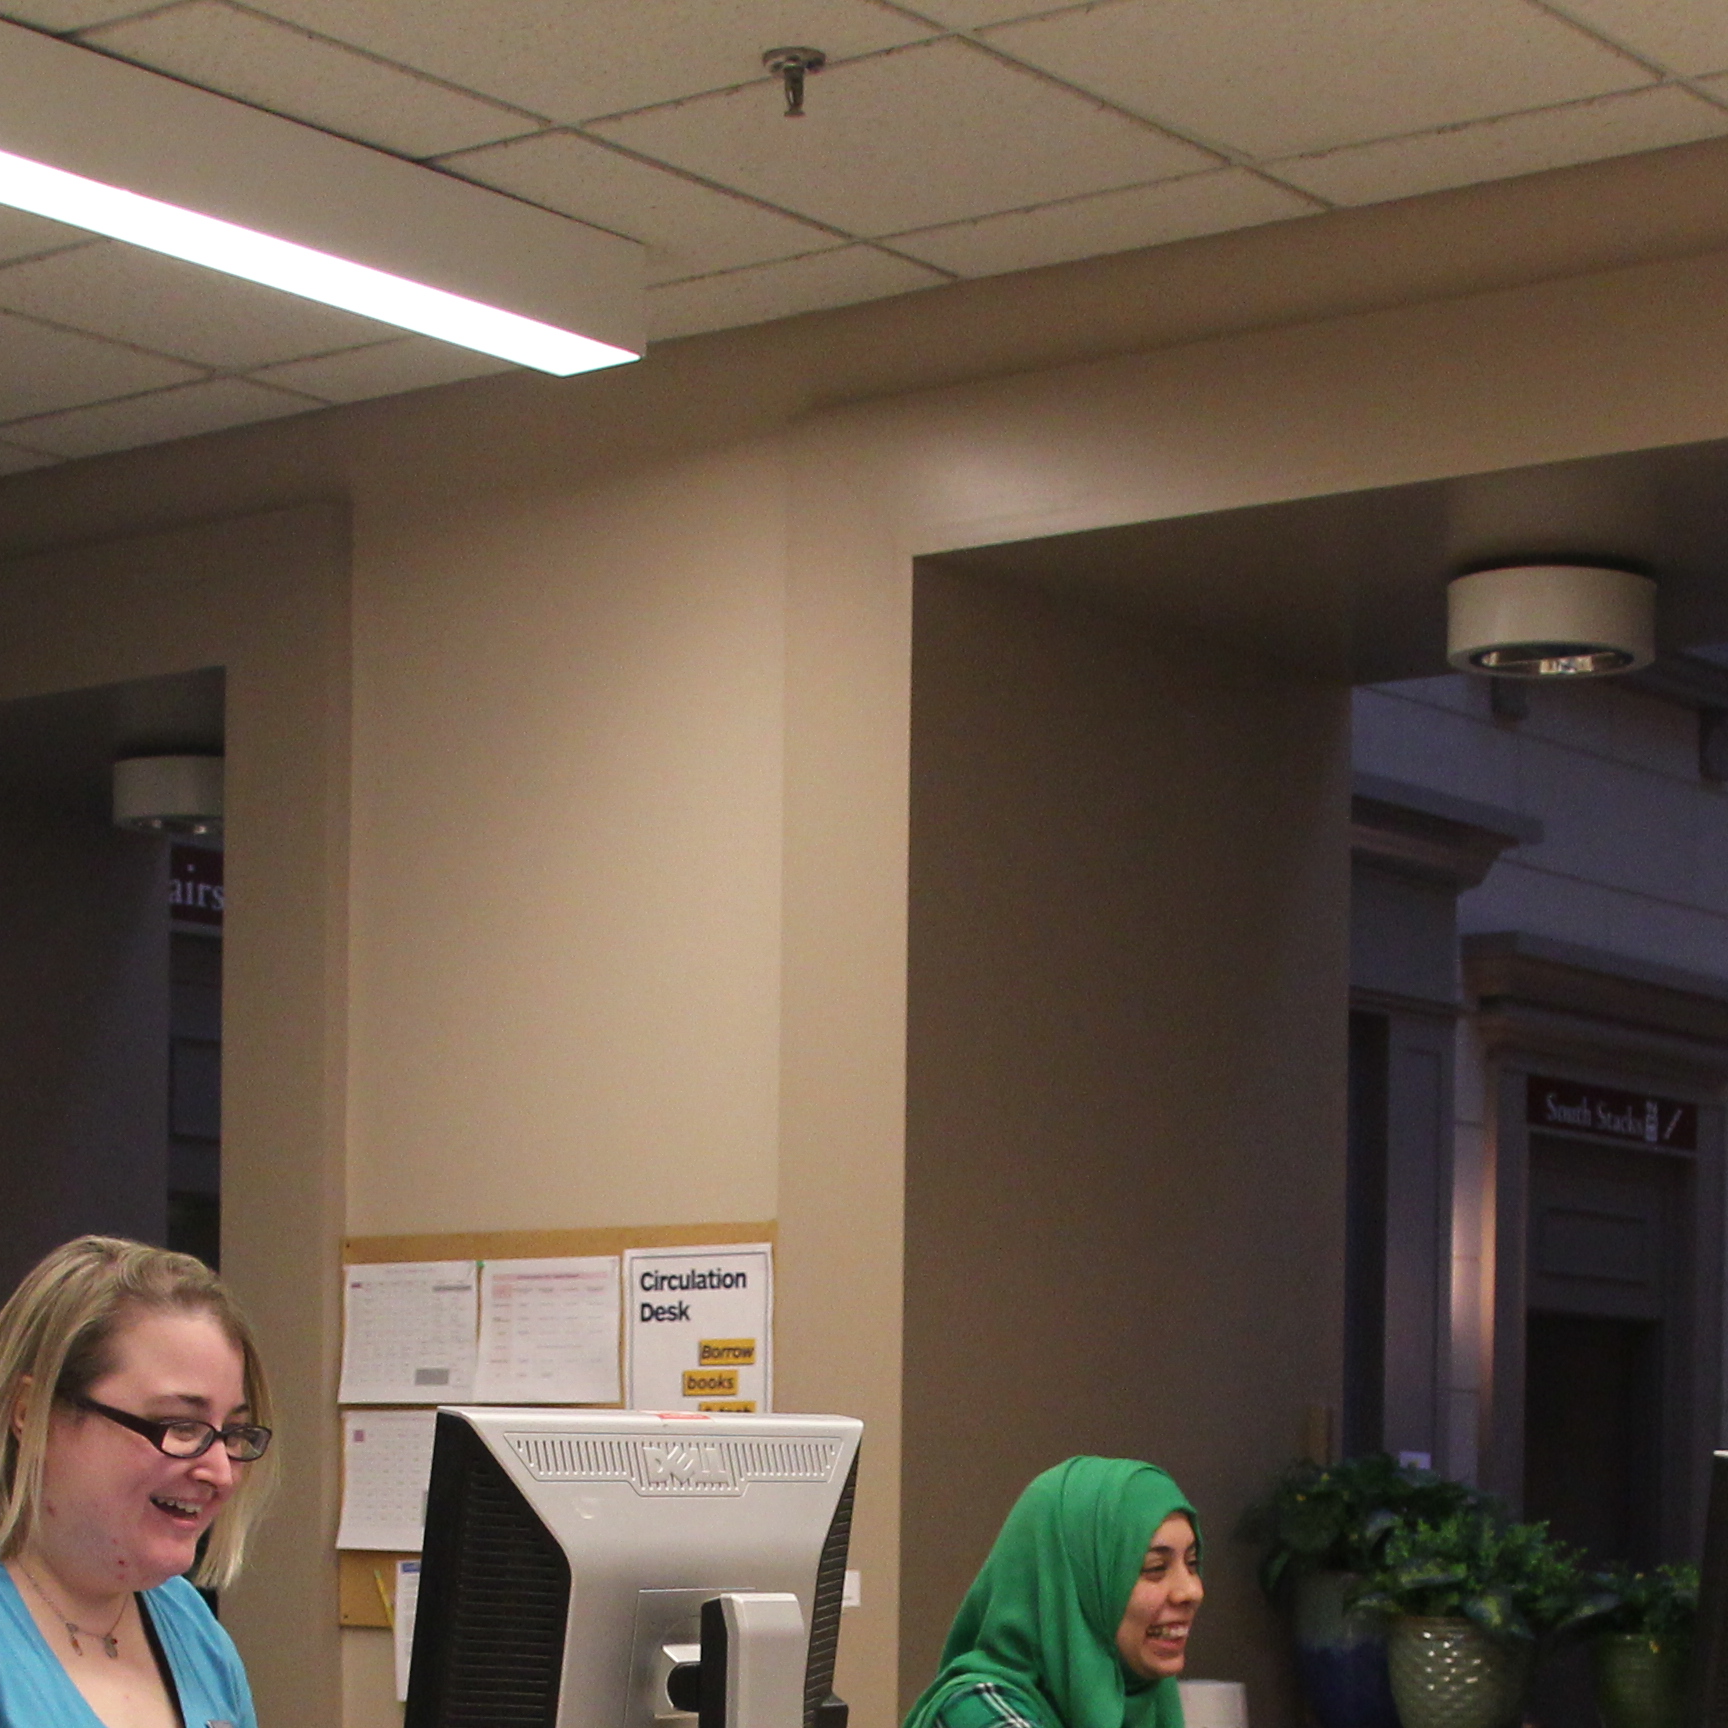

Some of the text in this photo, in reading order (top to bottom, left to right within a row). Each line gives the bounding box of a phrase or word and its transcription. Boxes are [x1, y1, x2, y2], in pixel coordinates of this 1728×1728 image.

[640, 1268, 747, 1291] Circulation
[640, 1301, 691, 1322] Desk
[702, 1345, 754, 1359] Borrow
[687, 1374, 734, 1390] books
